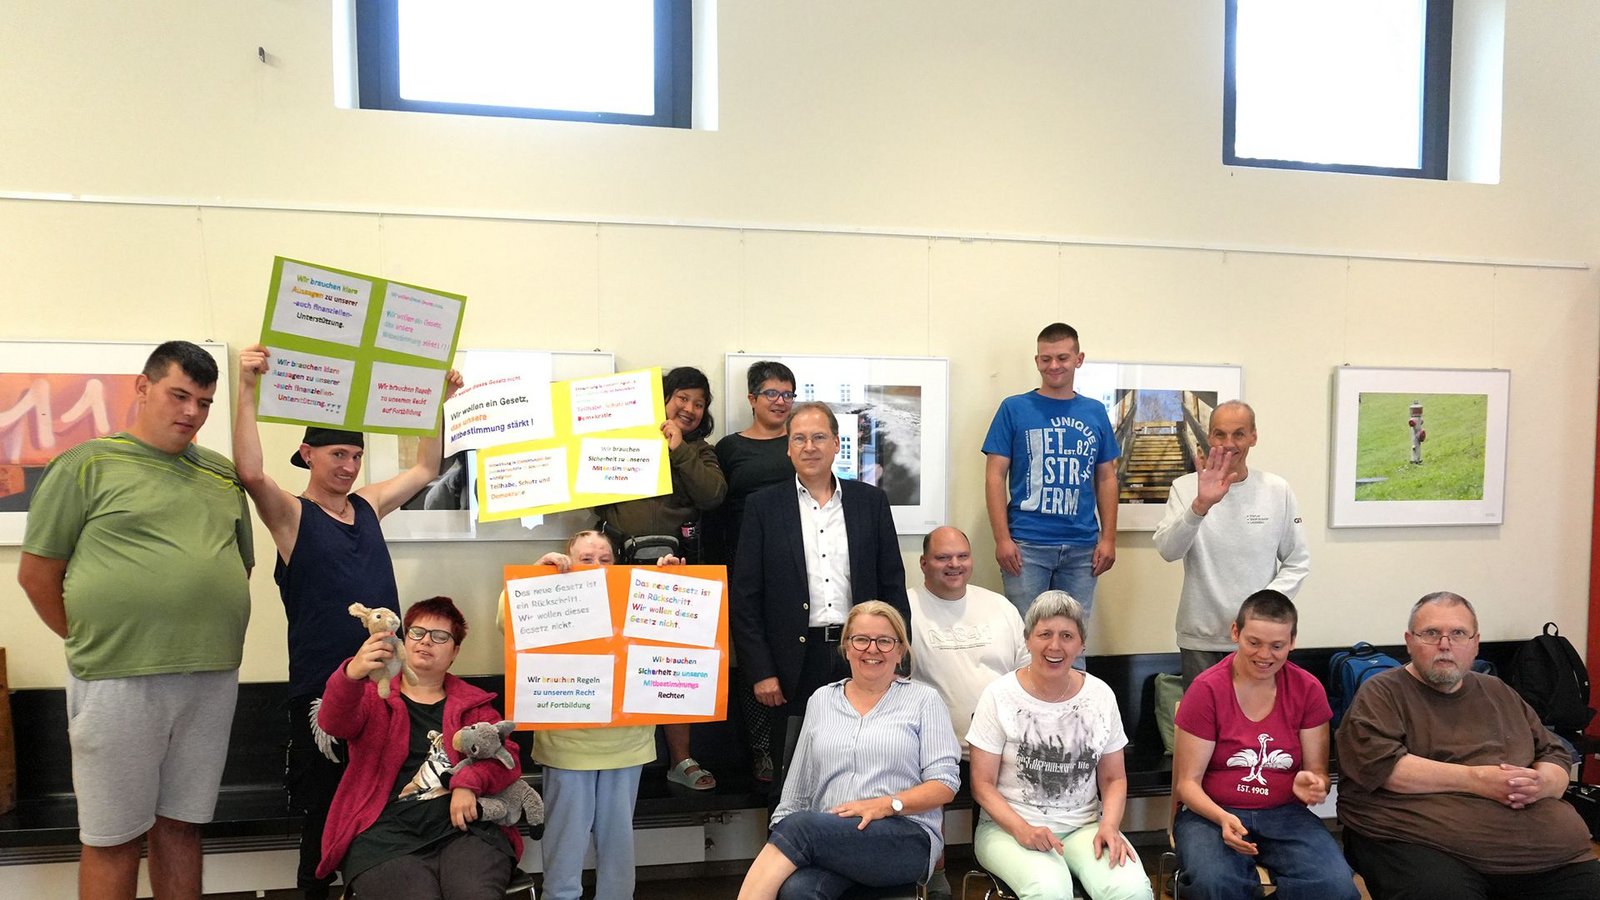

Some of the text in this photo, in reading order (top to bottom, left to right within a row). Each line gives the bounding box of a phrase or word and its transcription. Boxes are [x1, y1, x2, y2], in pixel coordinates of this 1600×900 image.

[297, 275, 309, 283] Wir
[310, 278, 341, 290] brauchen
[292, 286, 324, 299] Aussagen
[334, 296, 358, 307] unserer
[277, 358, 290, 366] Wir
[450, 396, 529, 421] Wir wollen ein Gesetz,
[451, 424, 505, 443] Mitbestimmung
[507, 419, 530, 430] stärkt
[1051, 417, 1096, 445] UNIQUE
[1076, 440, 1089, 456] 82
[515, 590, 530, 598] Das
[555, 583, 583, 592] Gesetz
[633, 591, 645, 599] ein
[635, 579, 649, 588] Das
[672, 584, 699, 595] Gesetz
[701, 589, 711, 597] ist
[516, 602, 529, 610] ein
[632, 603, 698, 619] Wir wollen dieses
[537, 611, 562, 620] wollen
[565, 607, 590, 616] dieses
[520, 621, 575, 635] Gesetz nicht.
[630, 615, 680, 629] Gesetz nicht.
[666, 657, 697, 665] brauchen
[638, 668, 672, 676] Sicherheit
[577, 676, 601, 684] Regeln
[550, 701, 591, 710] Fortbildung
[1237, 784, 1269, 796] EST. 1908
